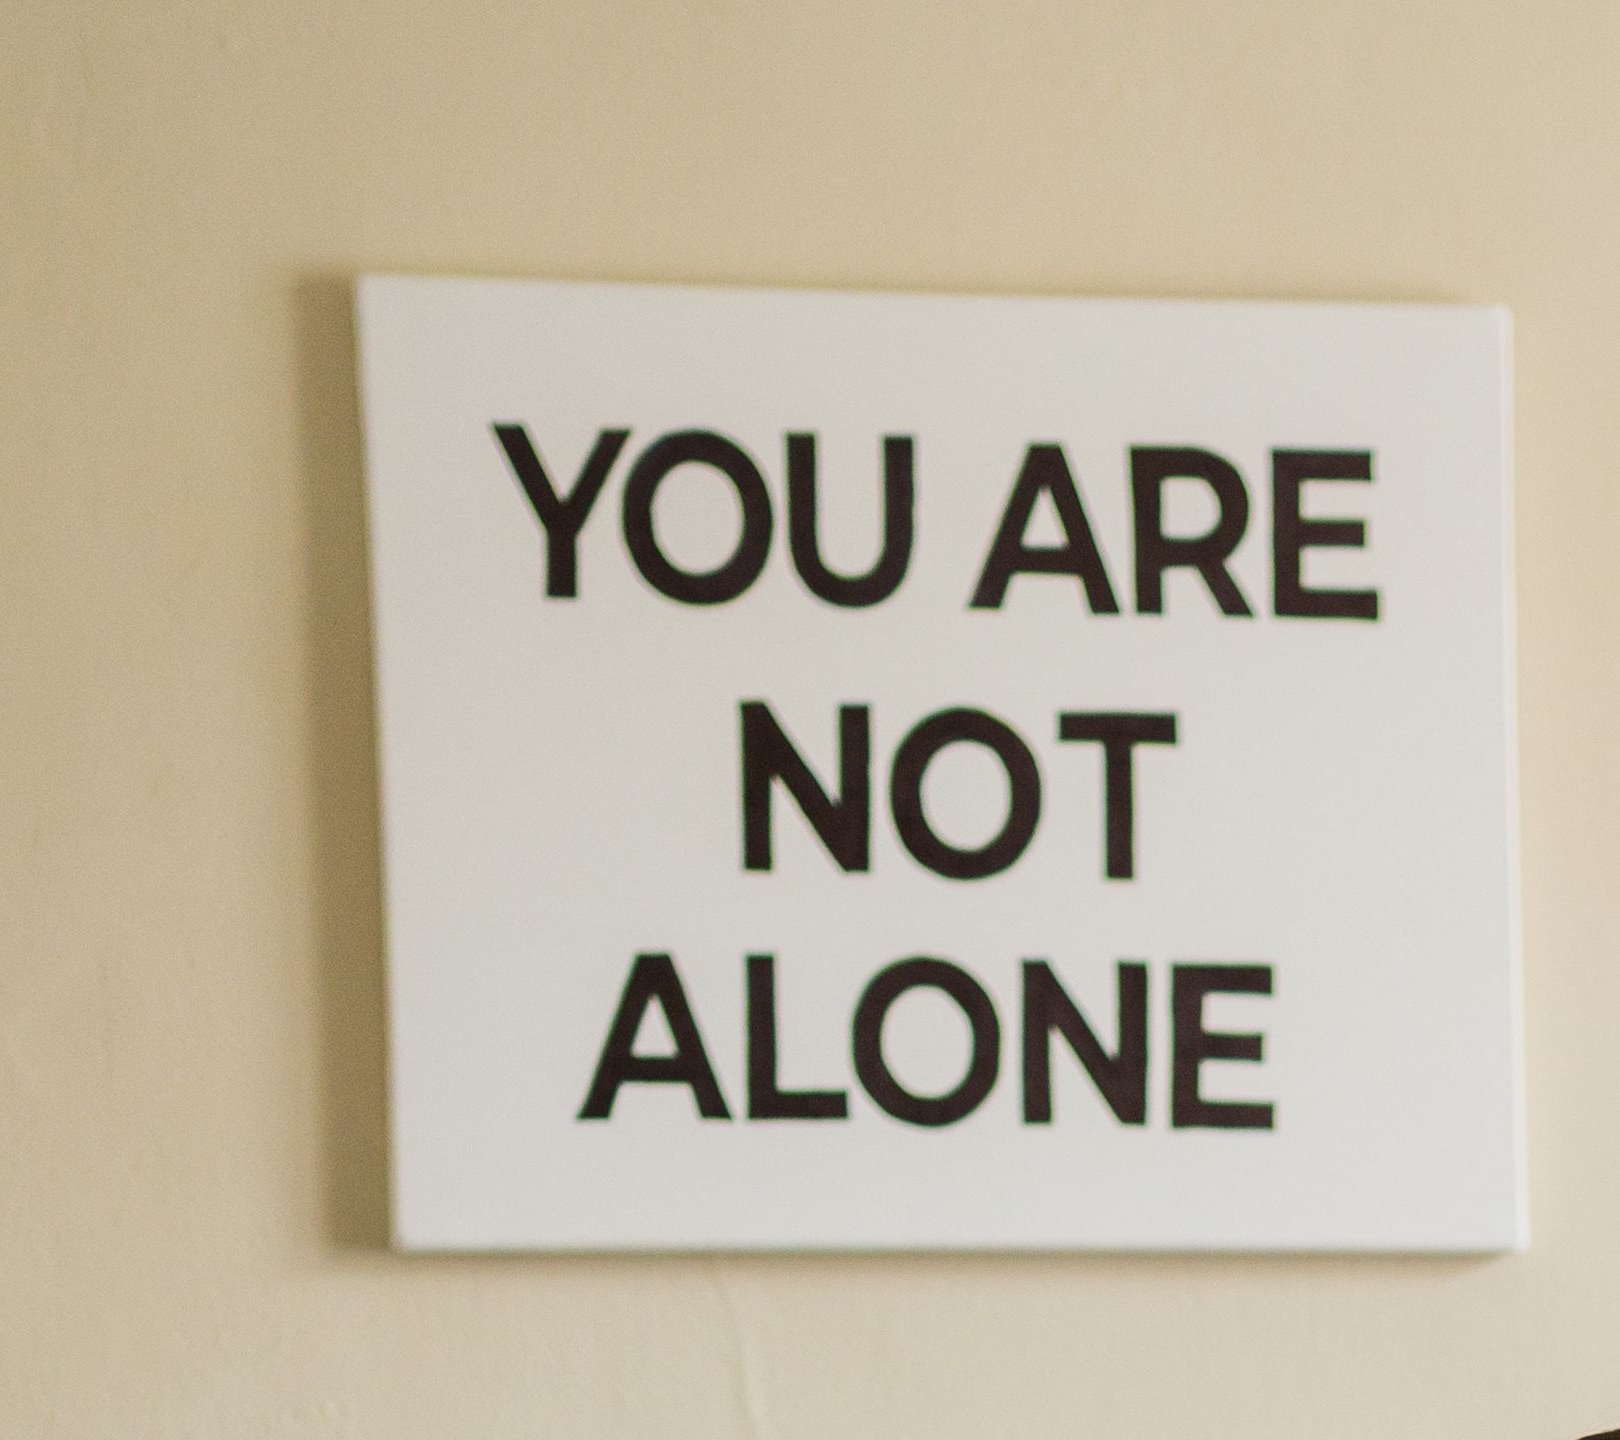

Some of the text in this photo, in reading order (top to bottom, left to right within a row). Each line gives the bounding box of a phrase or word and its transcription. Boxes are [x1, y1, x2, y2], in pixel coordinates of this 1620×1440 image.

[491, 421, 1381, 623] YOU ARE
[737, 699, 1179, 883] NOT
[575, 951, 1276, 1131] ALONE
